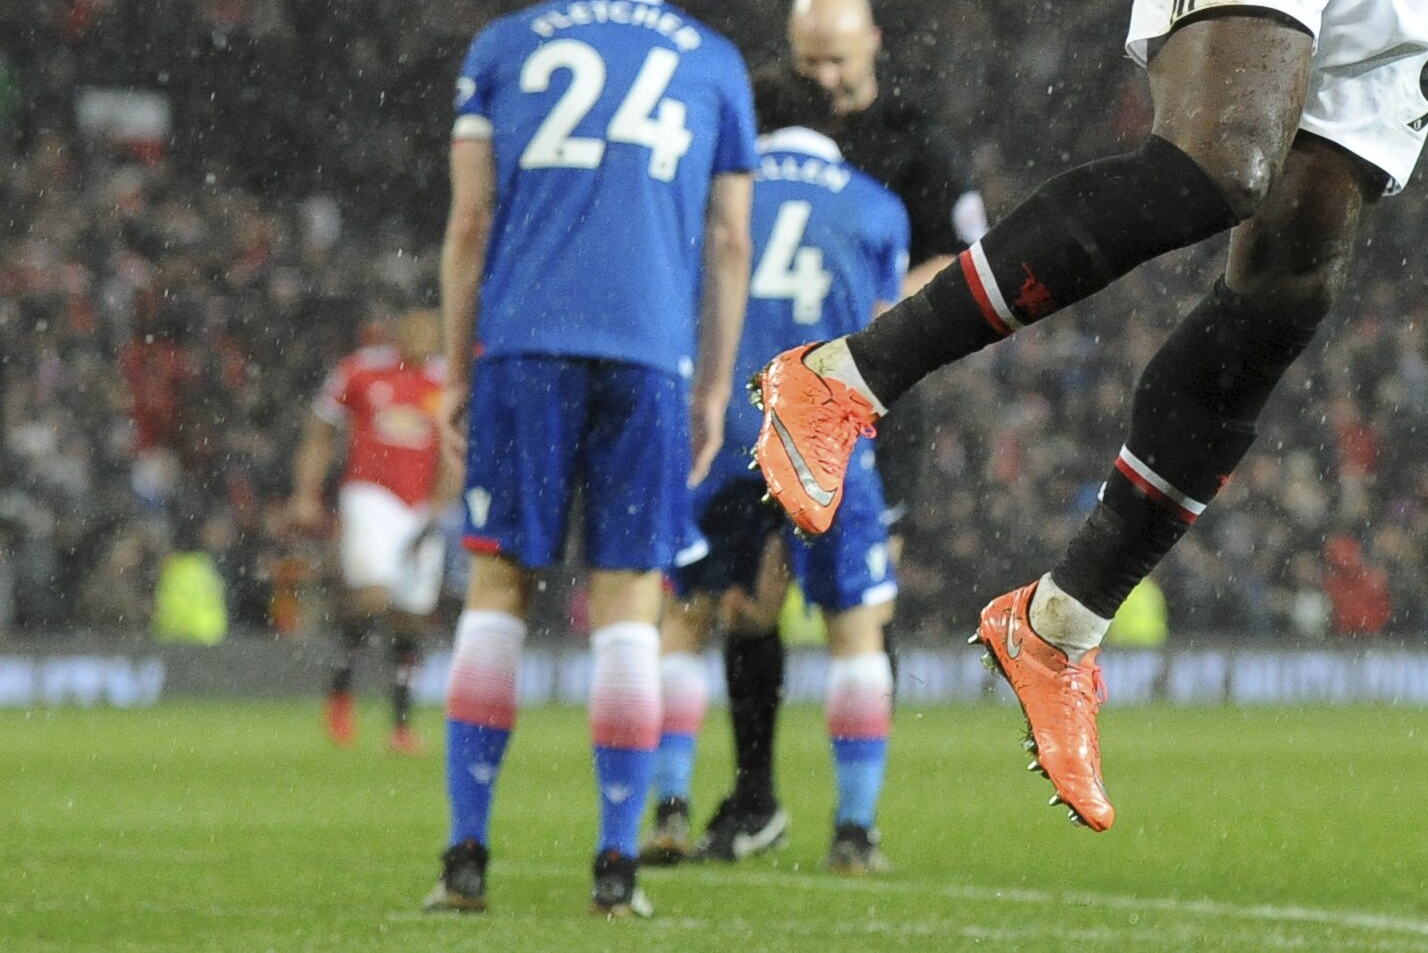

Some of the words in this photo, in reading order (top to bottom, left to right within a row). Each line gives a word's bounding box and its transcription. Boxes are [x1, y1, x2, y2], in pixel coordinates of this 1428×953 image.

[531, 0, 702, 53] FLETCHER
[519, 37, 693, 183] 24
[753, 155, 851, 194] LLEN
[751, 199, 834, 325] 4
